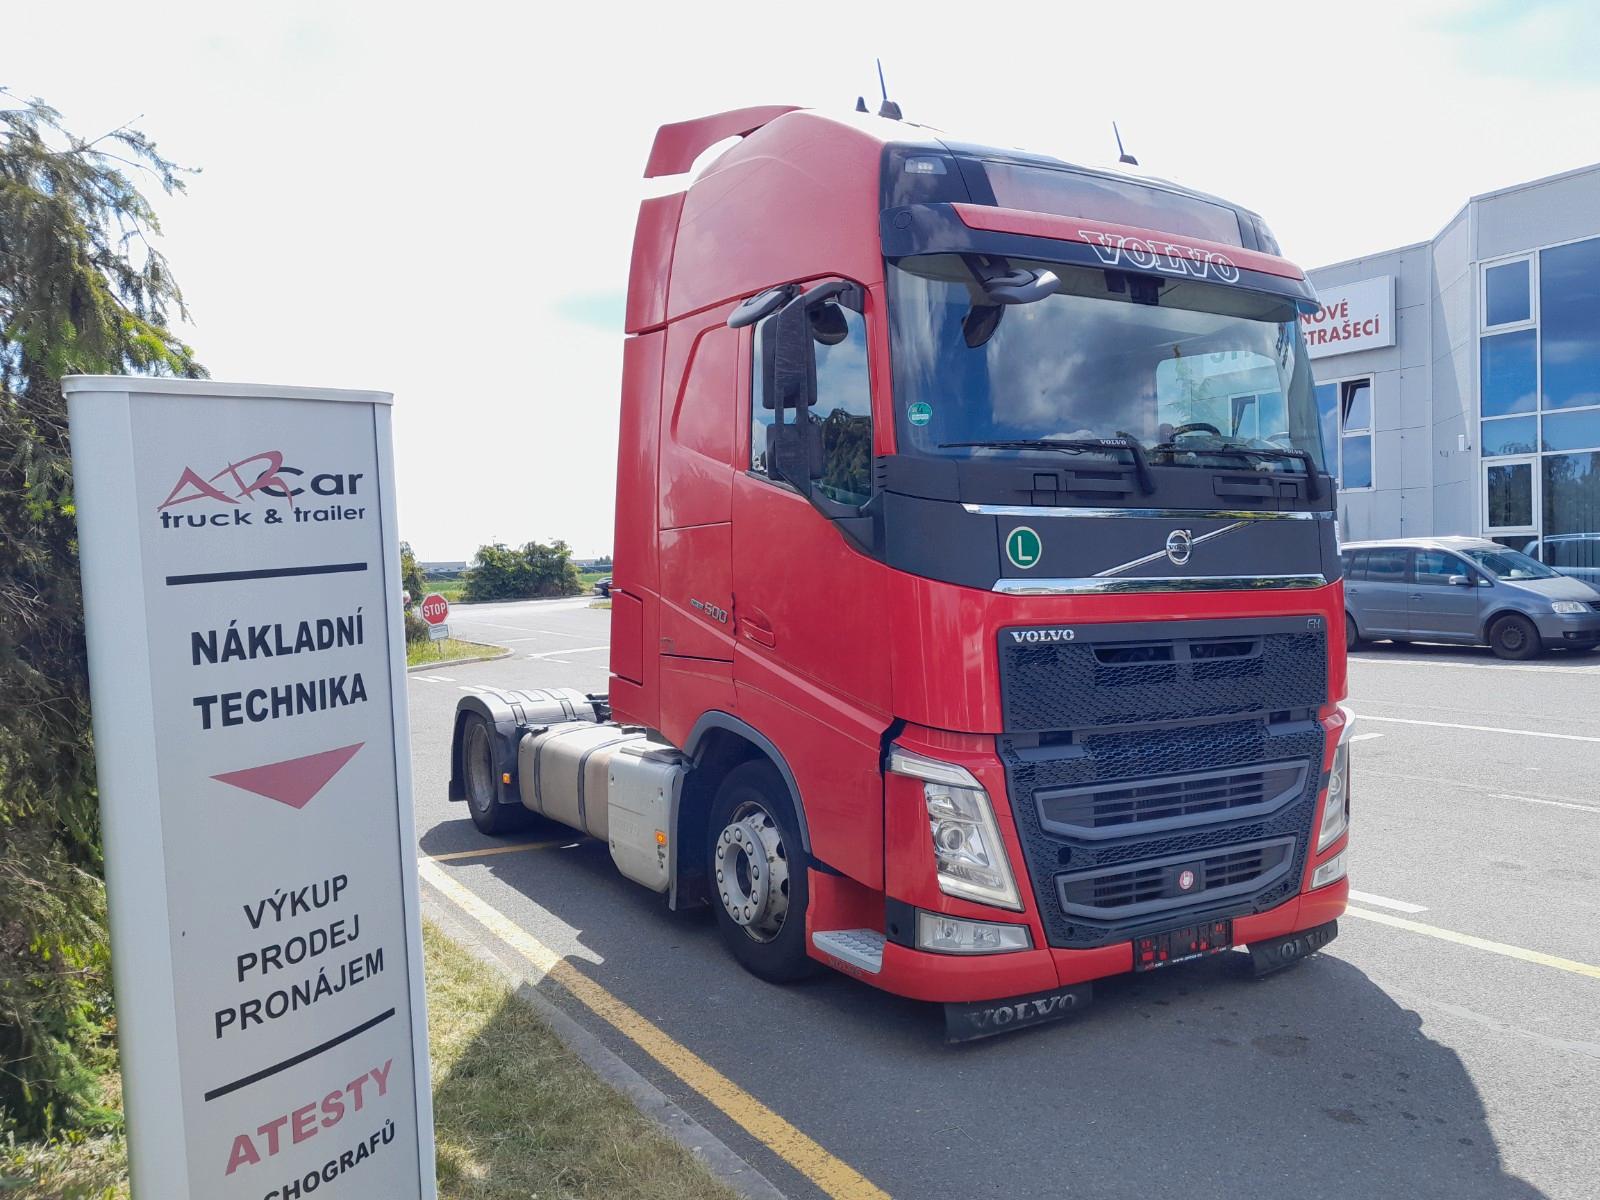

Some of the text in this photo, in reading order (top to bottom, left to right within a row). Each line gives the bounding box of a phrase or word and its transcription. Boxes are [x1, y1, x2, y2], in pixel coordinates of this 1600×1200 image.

[1078, 230, 1240, 284] VOLVO
[160, 505, 366, 529] truck & trailer
[1017, 535, 1033, 561] L
[191, 606, 364, 666] NÁKLADNÍ
[423, 602, 446, 617] STOP
[705, 601, 728, 624] 500
[1010, 629, 1075, 643] VOLVO
[193, 672, 368, 730] TECHNIKA
[242, 873, 349, 930] VÝKUP
[236, 914, 360, 982] PRODEJ
[214, 947, 385, 1039] PRONÁJEM
[963, 994, 1077, 1028] VOLVO
[224, 1057, 393, 1177] ATESTY
